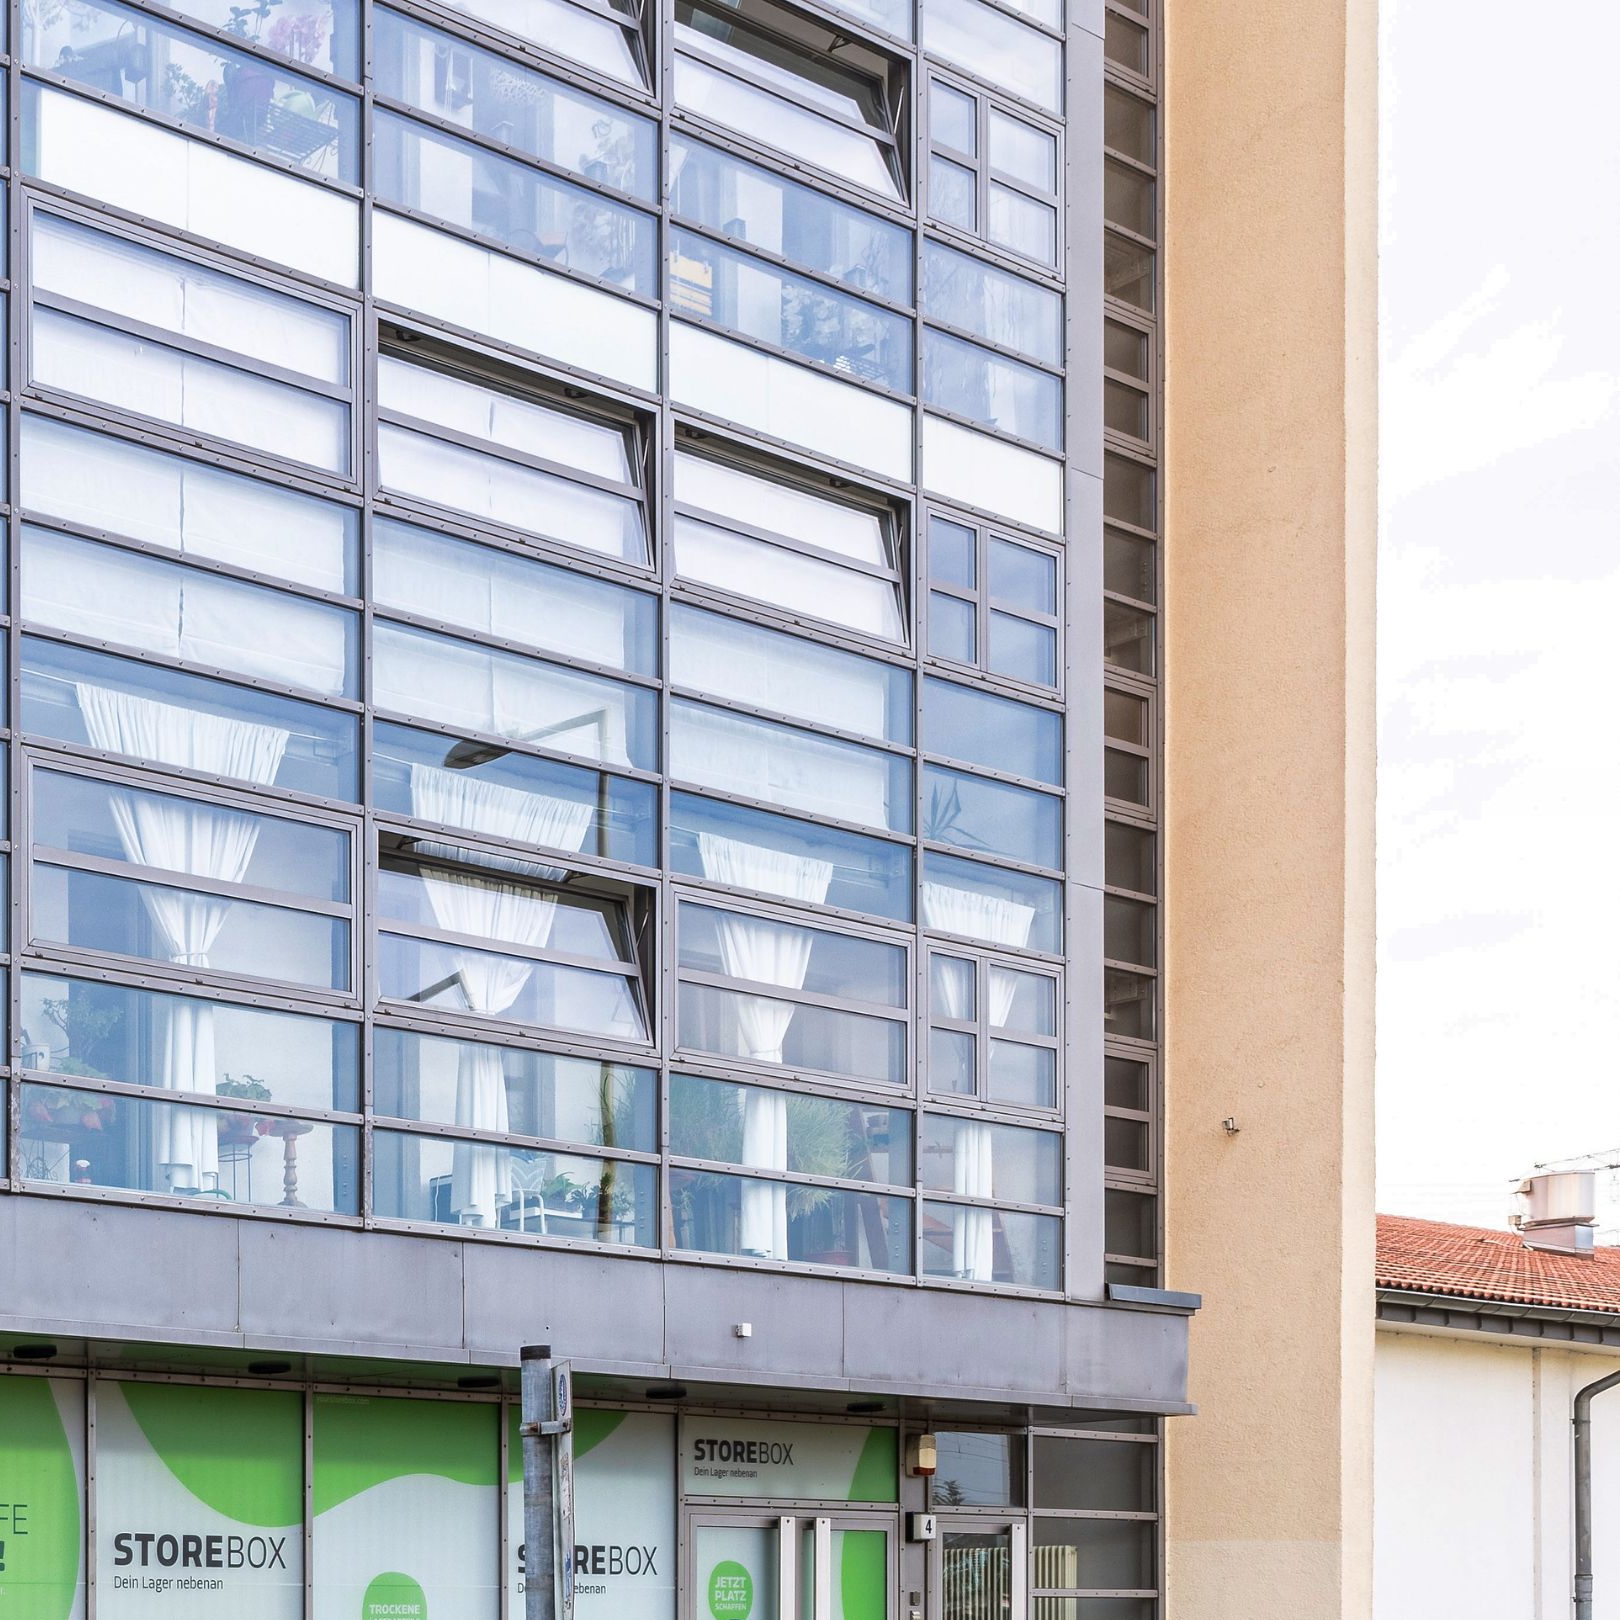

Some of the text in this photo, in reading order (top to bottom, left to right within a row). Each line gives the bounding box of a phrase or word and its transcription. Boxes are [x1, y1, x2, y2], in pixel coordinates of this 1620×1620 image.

[694, 1439, 794, 1466] STOREBOX
[694, 1466, 758, 1479] Dein Lager nebenan
[925, 1519, 933, 1534] 4
[114, 1532, 287, 1569] STOREBOX
[517, 1544, 658, 1576] SREBOX
[114, 1575, 224, 1593] Dein Lager nebenan
[573, 1583, 607, 1594] ebenan
[715, 1576, 746, 1589] JETZT
[715, 1590, 747, 1602] PLATZ
[369, 1604, 421, 1615] TROCKENE
[715, 1602, 747, 1611] SCHAFFEN
